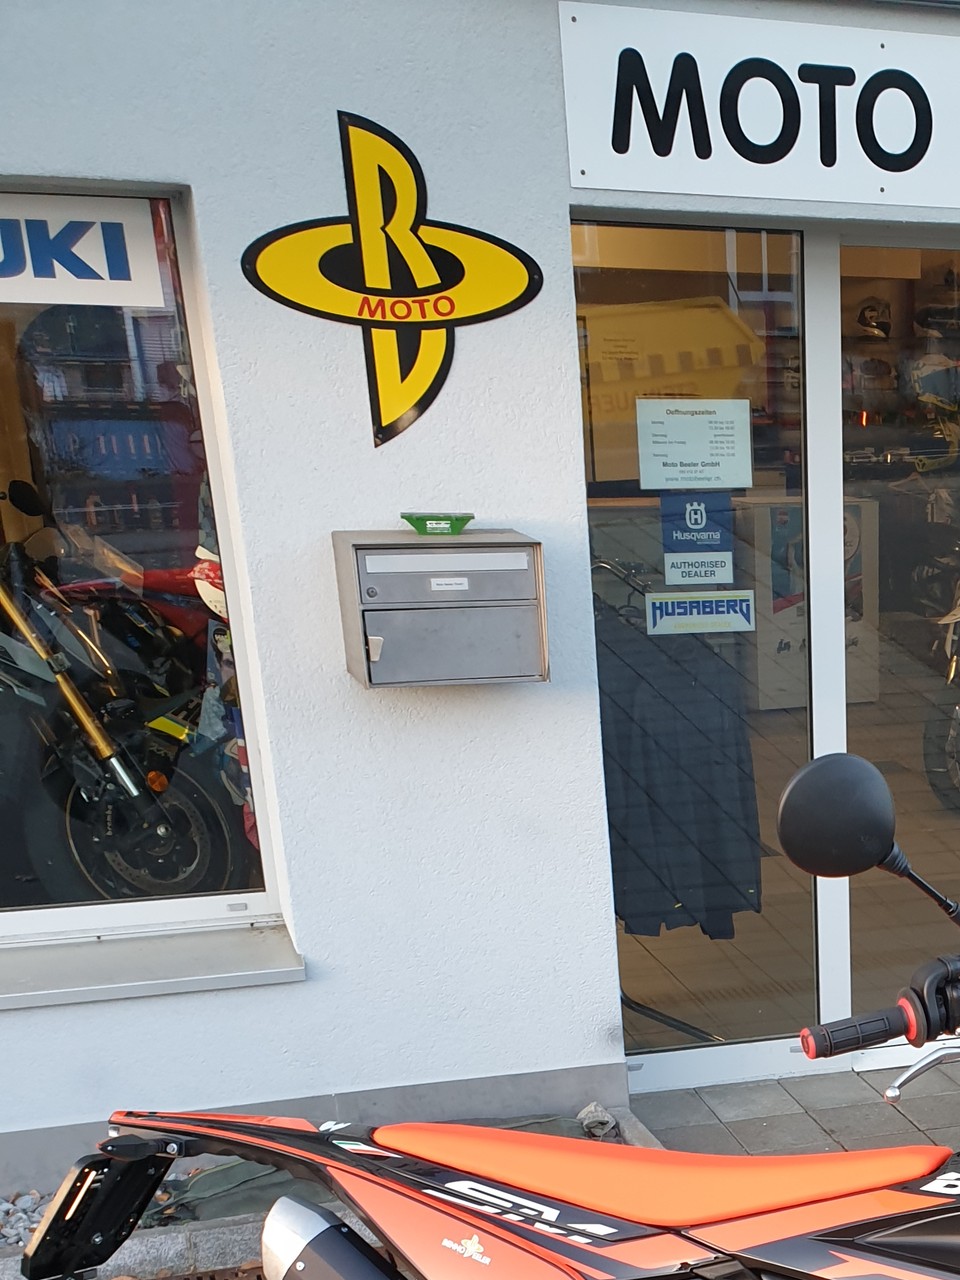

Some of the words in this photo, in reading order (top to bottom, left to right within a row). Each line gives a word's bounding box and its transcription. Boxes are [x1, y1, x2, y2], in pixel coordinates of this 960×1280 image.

[611, 46, 934, 173] MOTO
[358, 295, 456, 320] MOTO
[665, 408, 717, 417] Oeffnungszeiten
[672, 530, 721, 542] Husqvarna
[670, 560, 727, 570] AUTHORISED
[681, 570, 716, 579] DEALER
[651, 599, 752, 630] HUSABERG
